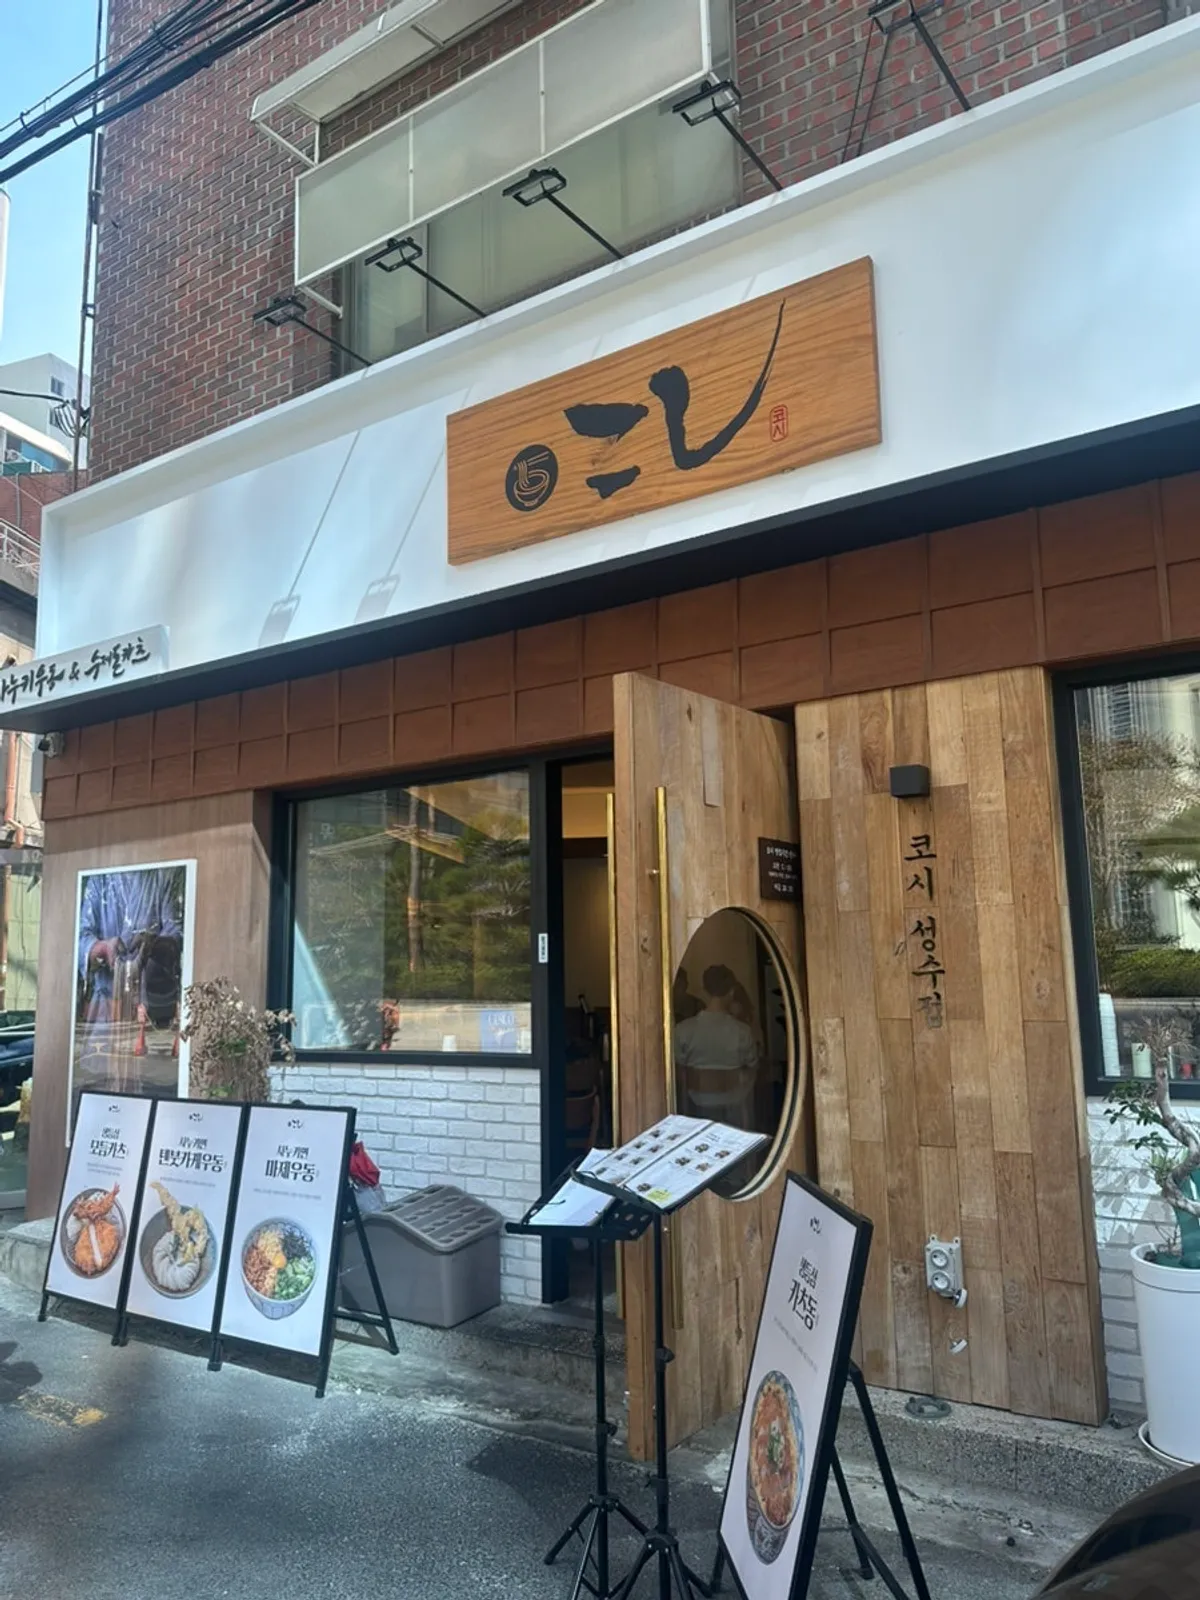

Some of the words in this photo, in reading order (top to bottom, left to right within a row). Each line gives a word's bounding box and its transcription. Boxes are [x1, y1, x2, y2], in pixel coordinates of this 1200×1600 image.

[772, 407, 786, 438] 코시
[69, 661, 80, 681] &
[85, 637, 152, 682] 수제돈카츠
[904, 834, 937, 901] 코시
[909, 915, 946, 1030] 성수점
[265, 1159, 316, 1183] 마제우동
[787, 1278, 819, 1331] 카츠동
